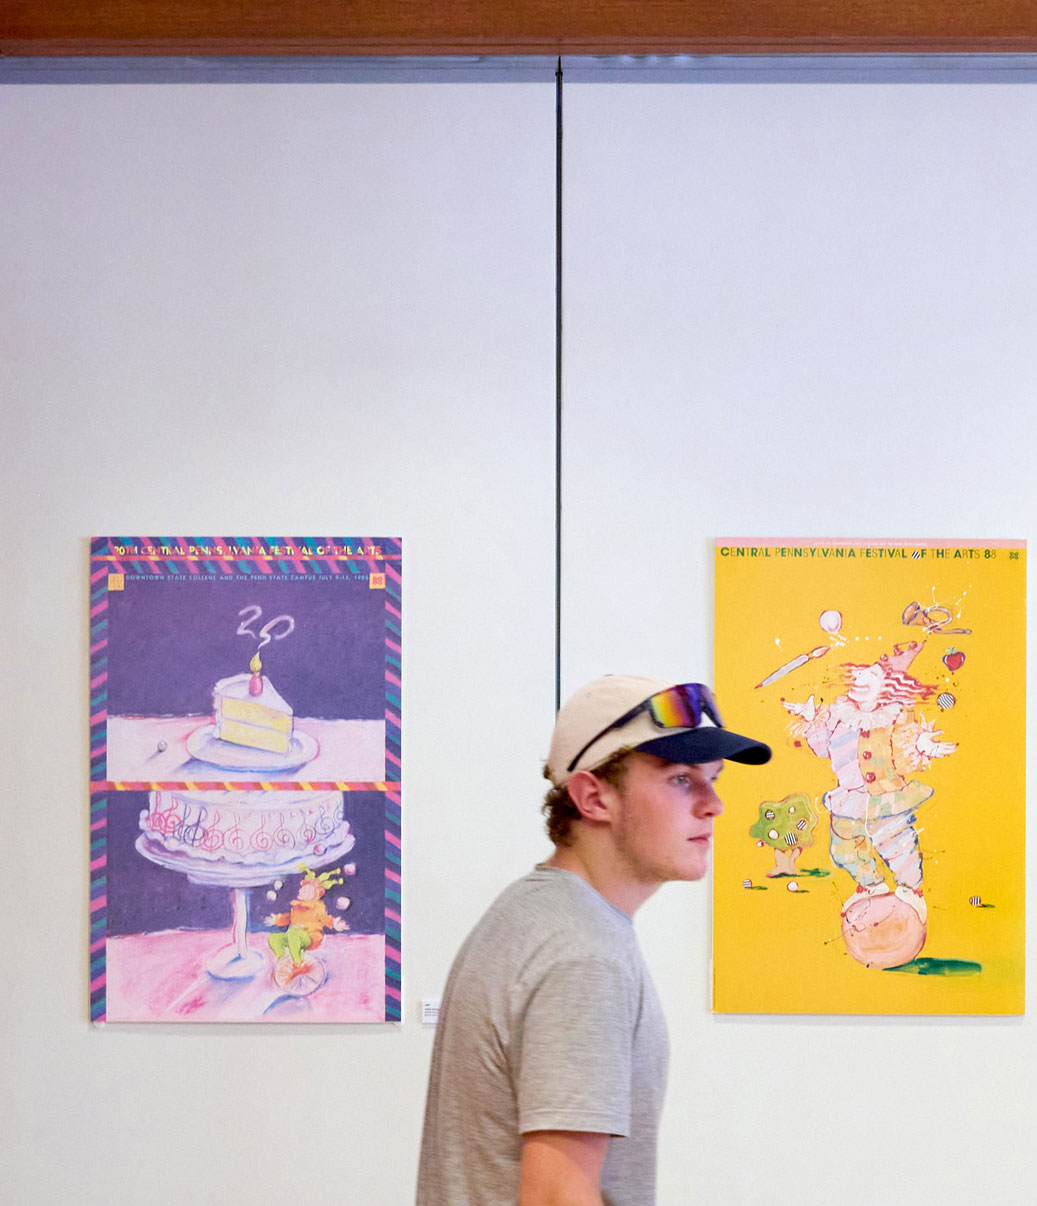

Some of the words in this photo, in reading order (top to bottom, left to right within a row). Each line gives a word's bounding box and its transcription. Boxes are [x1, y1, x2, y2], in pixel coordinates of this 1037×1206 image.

[141, 545, 185, 556] CENTRAL
[269, 545, 313, 556] FESTIVAL
[316, 545, 331, 556] OF
[334, 545, 352, 556] THE
[356, 545, 382, 556] ARTS
[720, 546, 771, 558] CENTRAL
[775, 546, 856, 559] PENNSYLVANIA
[860, 547, 907, 559] FESTIVAL
[930, 548, 949, 559] THE
[954, 548, 980, 559] ARTS
[984, 548, 997, 559] 88
